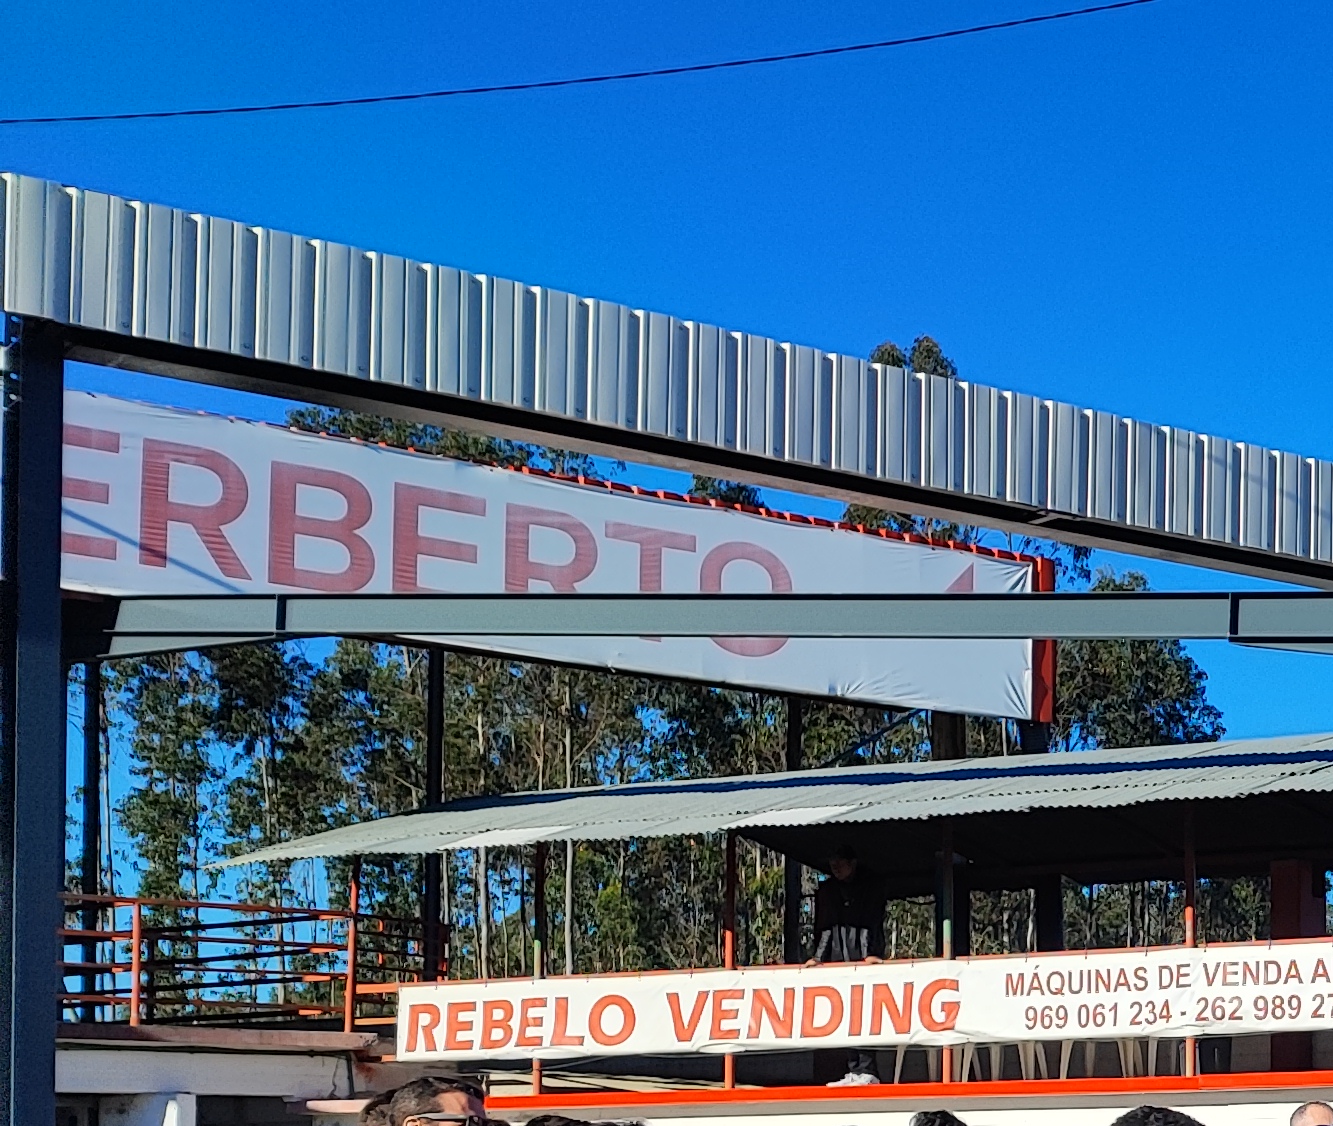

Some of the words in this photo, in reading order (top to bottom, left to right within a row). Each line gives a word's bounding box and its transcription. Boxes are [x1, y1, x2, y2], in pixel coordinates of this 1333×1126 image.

[1005, 964, 1149, 998] MÁQUINAS
[1158, 963, 1192, 990] DE
[1203, 959, 1303, 987] VENDA
[404, 994, 637, 1053] REBELO
[665, 978, 961, 1043] VENDING
[1024, 1005, 1069, 1031] 969
[1077, 1002, 1118, 1029] 061
[1129, 999, 1173, 1026] 234
[1194, 996, 1244, 1022] 262
[1253, 994, 1302, 1020] 989
